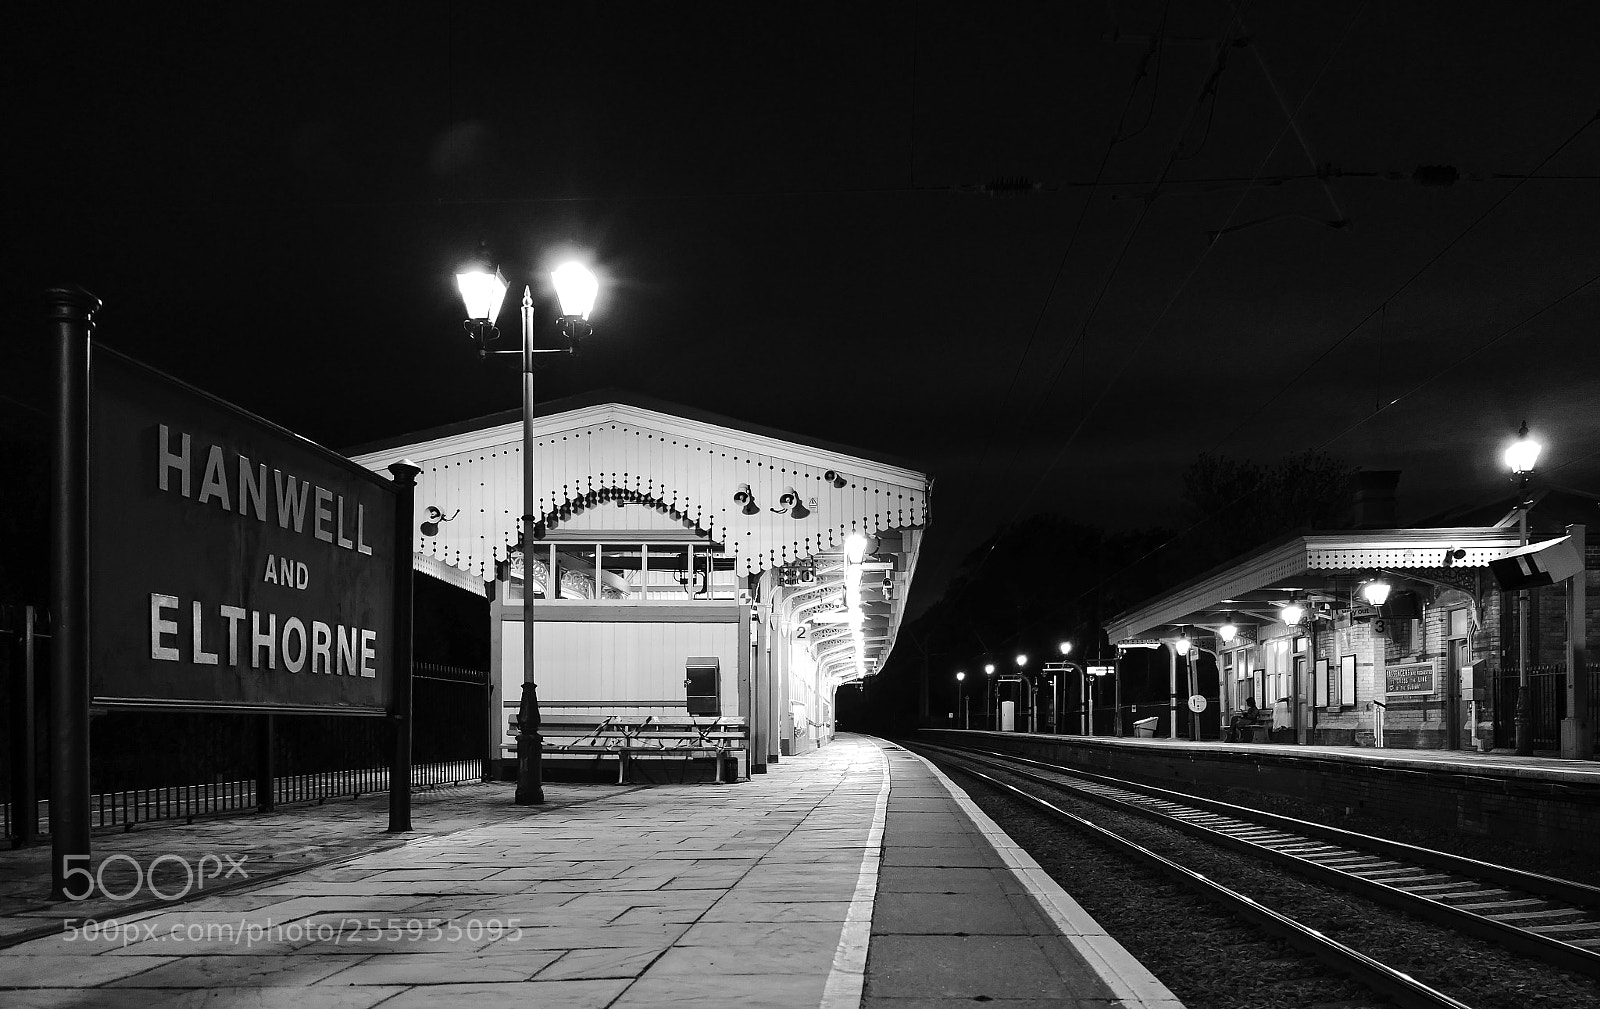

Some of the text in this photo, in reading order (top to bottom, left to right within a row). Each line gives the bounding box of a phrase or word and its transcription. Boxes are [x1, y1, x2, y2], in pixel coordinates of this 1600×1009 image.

[158, 423, 373, 556] HANWELL
[264, 554, 309, 590] AND
[779, 569, 797, 577] Help
[150, 592, 377, 679] ELTHORNE
[796, 626, 806, 638] 2
[1375, 620, 1385, 633] 3
